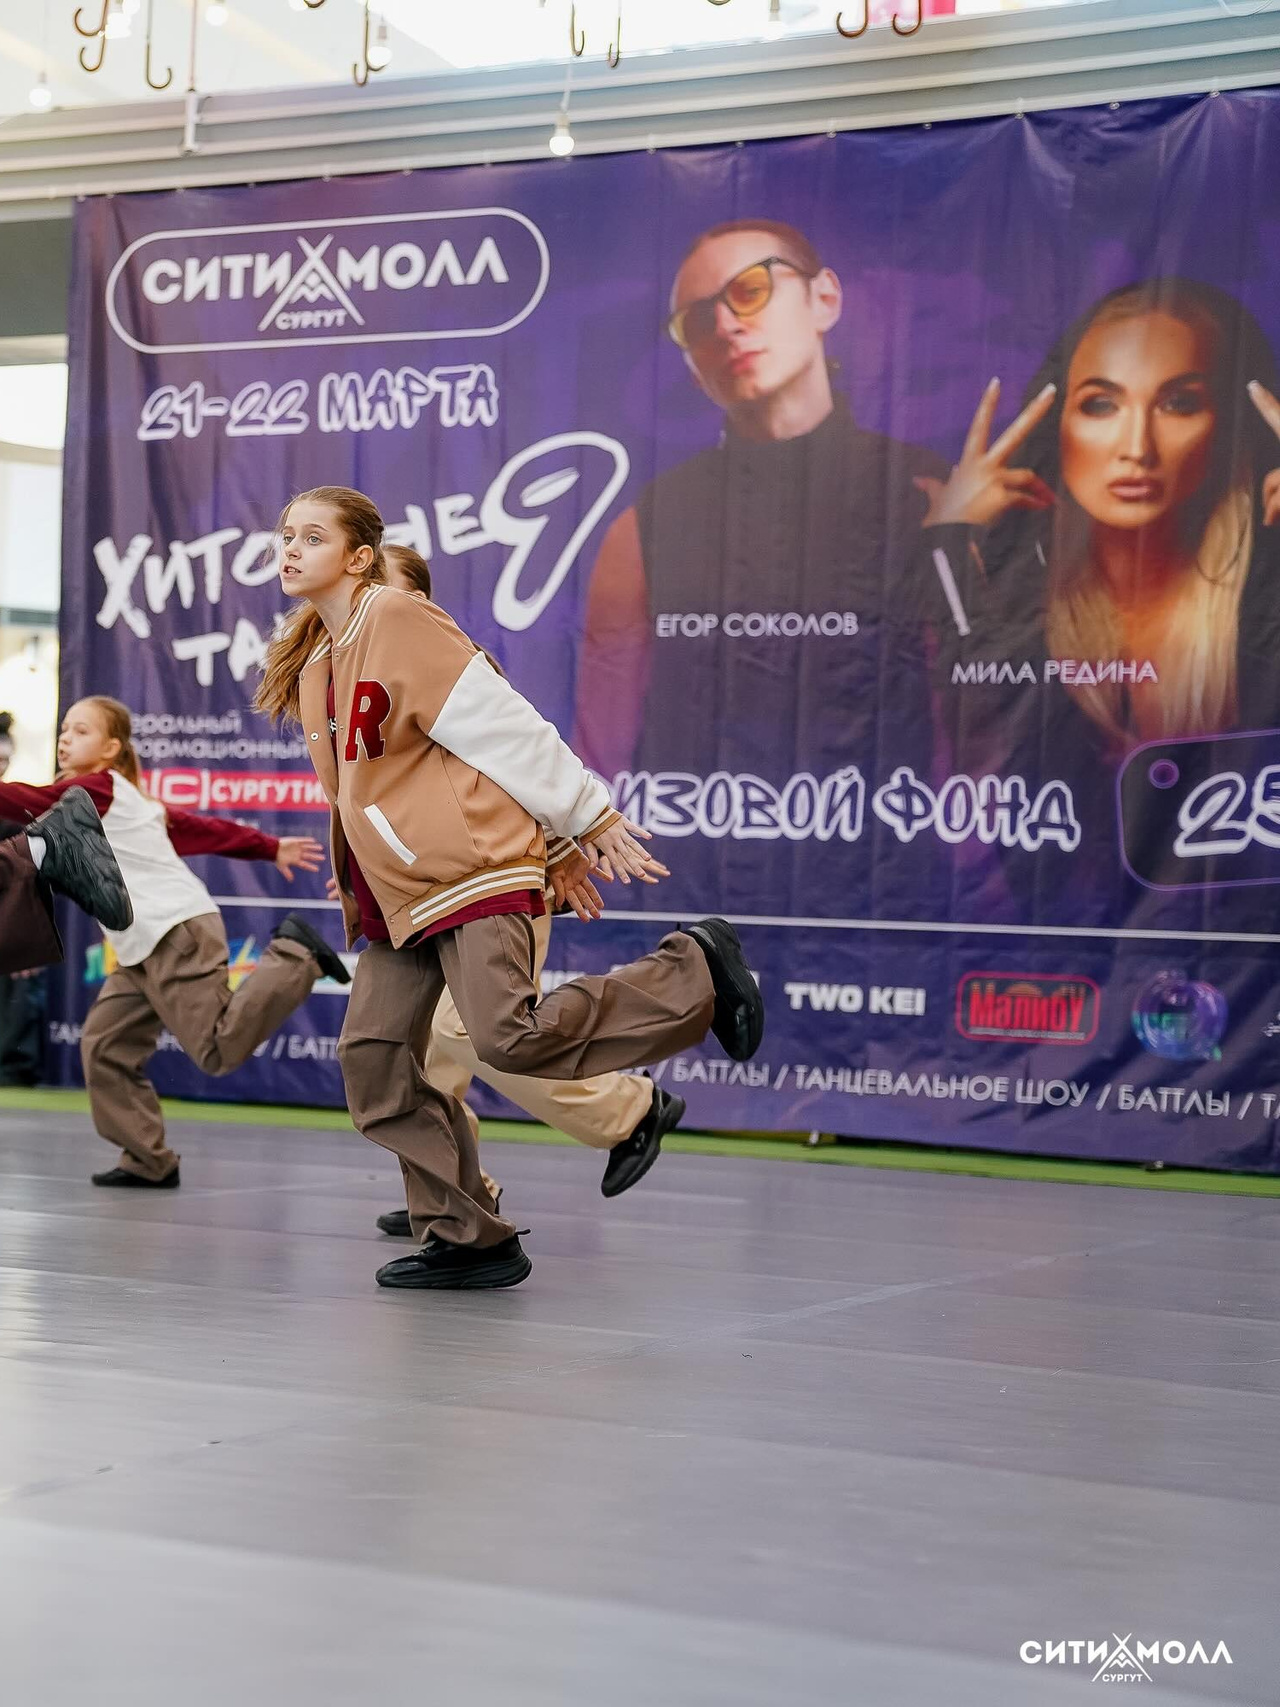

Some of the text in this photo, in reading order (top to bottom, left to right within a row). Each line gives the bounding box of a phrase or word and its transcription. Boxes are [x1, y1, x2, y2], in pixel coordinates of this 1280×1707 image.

[274, 306, 349, 331] СУРГУТ
[137, 363, 500, 441] 21-22 МАРТА
[655, 611, 860, 638] ЕГОР СОКОЛОВ
[950, 659, 1159, 687] МИЛА РЕДИНА
[344, 678, 393, 763] R
[586, 765, 866, 842] ИЗОВОЙ
[872, 766, 1081, 853] ФОНД
[783, 981, 926, 1016] TWO KEI
[671, 1056, 770, 1088] БАТТЛЫ
[793, 1063, 1011, 1103] ТАНЦЕВАЛЬНОЕ
[1015, 1077, 1090, 1108] ШОУ
[1118, 1083, 1231, 1118] БАТТЛЫ
